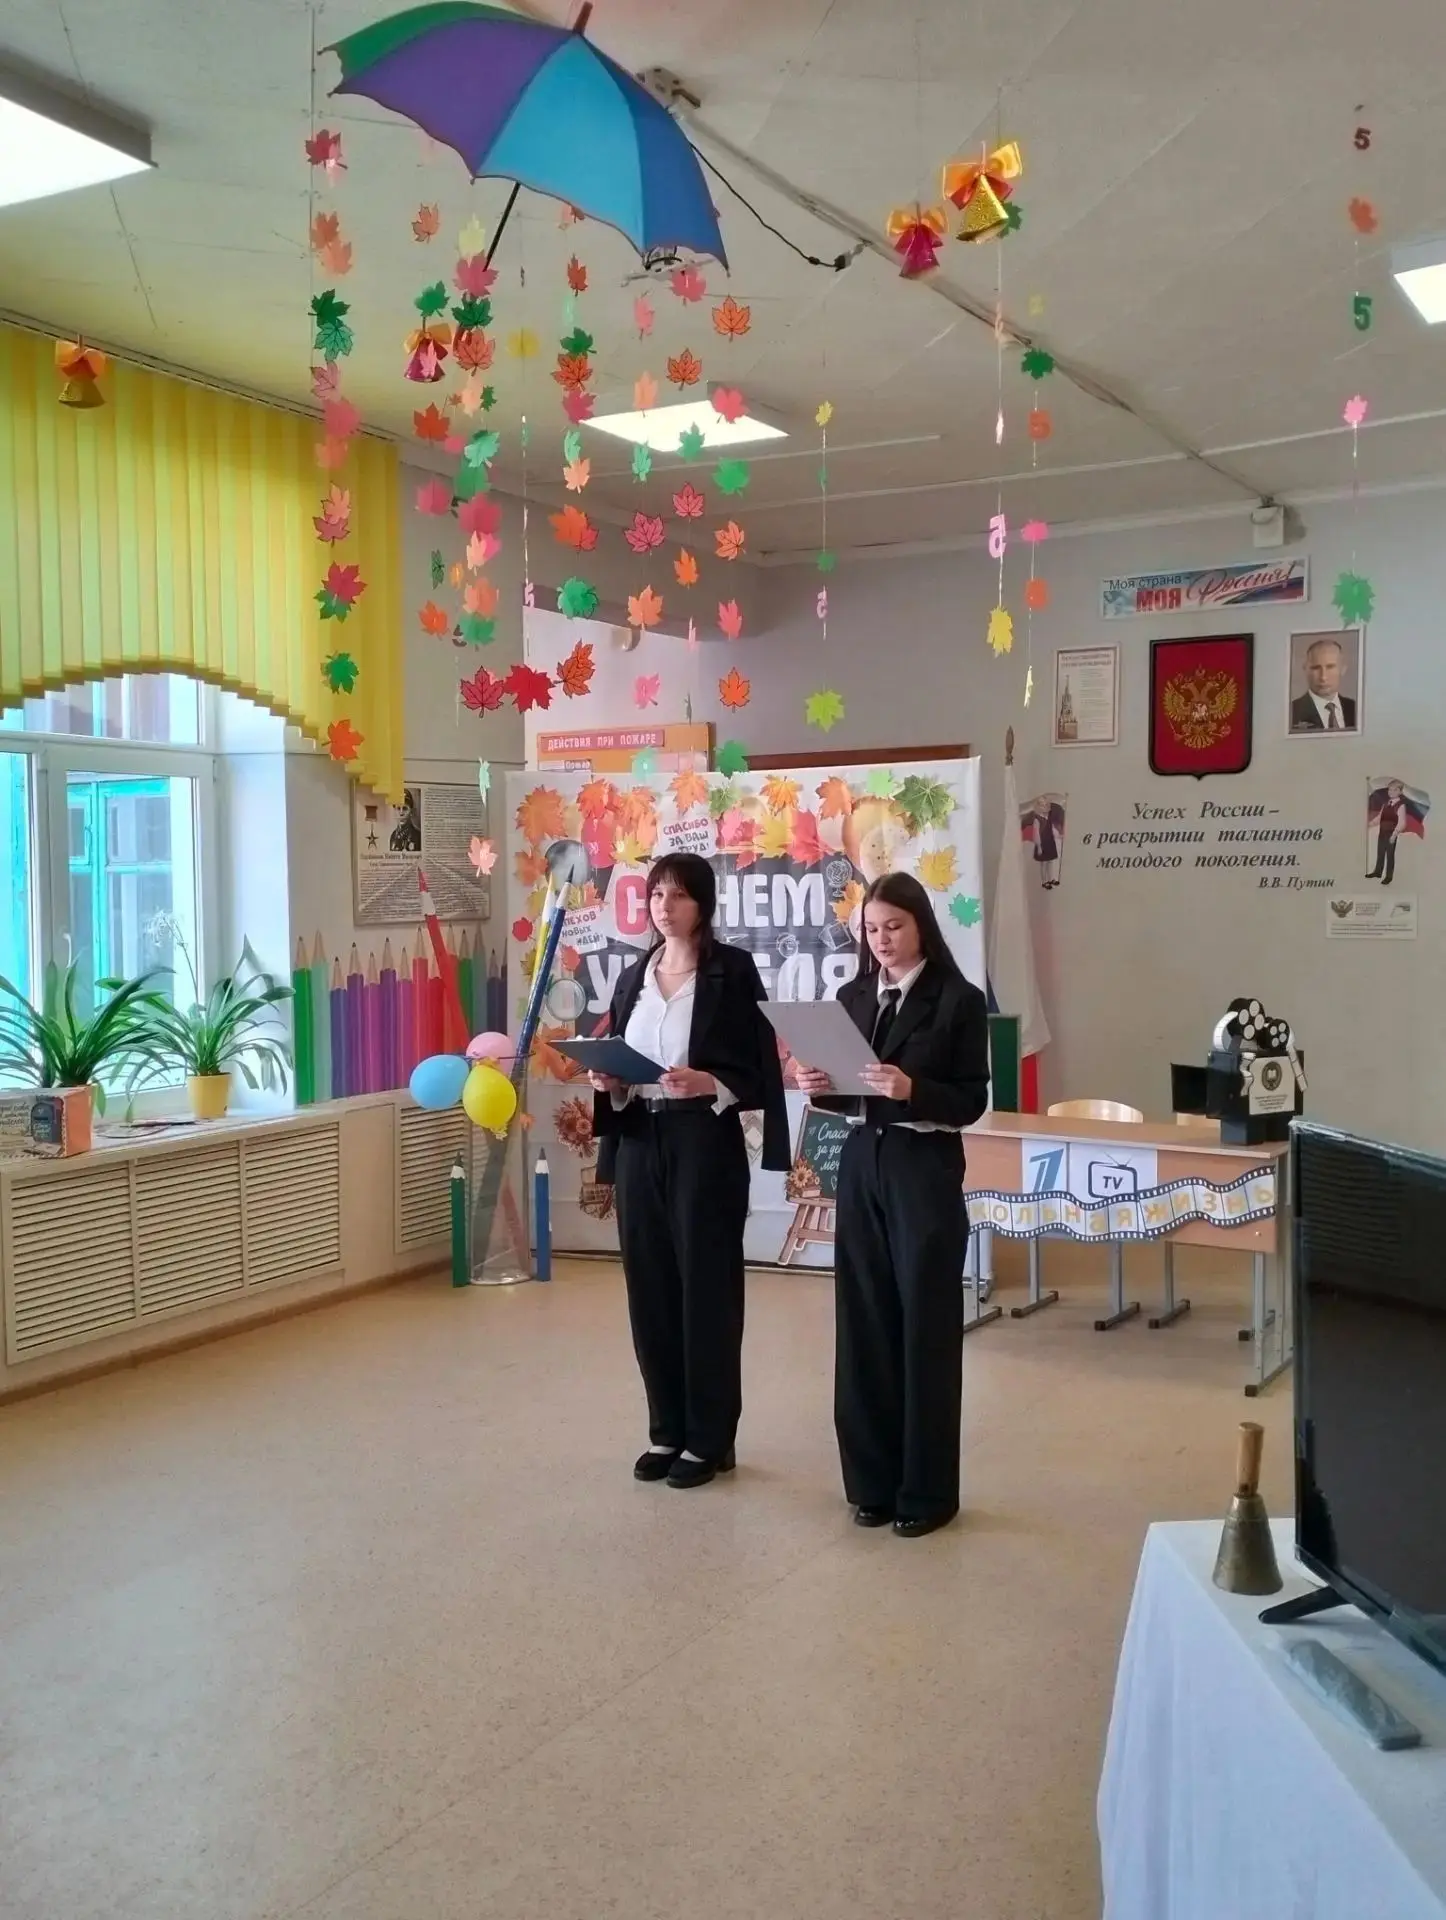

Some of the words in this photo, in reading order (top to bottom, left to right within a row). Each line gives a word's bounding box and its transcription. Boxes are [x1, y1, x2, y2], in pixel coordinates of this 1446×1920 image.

[1354, 127, 1371, 150] 5
[1354, 297, 1372, 331] 5
[1109, 578, 1135, 590] Моя
[1139, 575, 1182, 590] страна
[1136, 587, 1182, 612] МОЯ
[1186, 561, 1296, 606] Россия!
[547, 737, 591, 751] ДЕЙСТВИЯ
[597, 736, 614, 747] ПРИ
[620, 734, 656, 745] ПОЖАРЕ
[1132, 803, 1187, 819] Успех
[1199, 801, 1265, 818] России
[663, 818, 709, 836] СПАСИБО
[668, 836, 684, 847] ЗА
[685, 830, 709, 843] ВАШ
[1082, 833, 1092, 845] в
[1097, 829, 1205, 848] раскрытии
[1218, 827, 1324, 842] талантов
[678, 842, 710, 854] ТРУД!
[1096, 852, 1182, 868] молодого
[1195, 852, 1301, 868] поколения.
[1286, 876, 1335, 891] Путин
[615, 875, 650, 936] С
[713, 873, 826, 929] НЕМ
[563, 911, 597, 926] ПЕХОВ
[818, 1122, 850, 1141] Спаси
[814, 1144, 828, 1161] за
[828, 1144, 843, 1160] де
[820, 1159, 840, 1171] меч
[1102, 1176, 1124, 1190] TV
